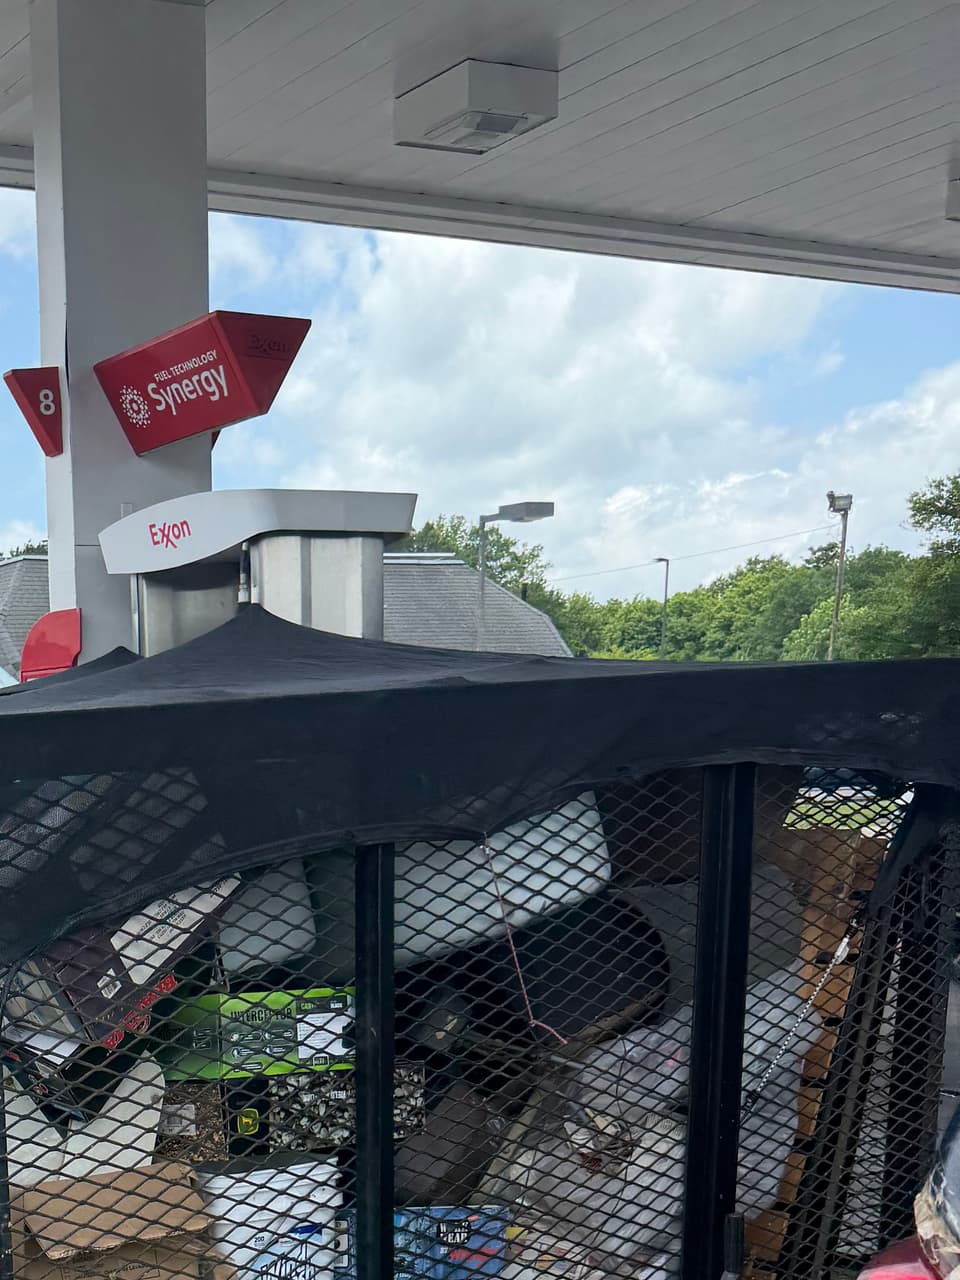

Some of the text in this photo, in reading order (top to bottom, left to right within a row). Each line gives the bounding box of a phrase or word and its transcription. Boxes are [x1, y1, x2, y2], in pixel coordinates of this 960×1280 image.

[154, 349, 218, 382] FUEL TECHNOLOGY
[39, 389, 56, 416] 8
[147, 365, 229, 416] Synergy
[149, 519, 191, 549] Exxon
